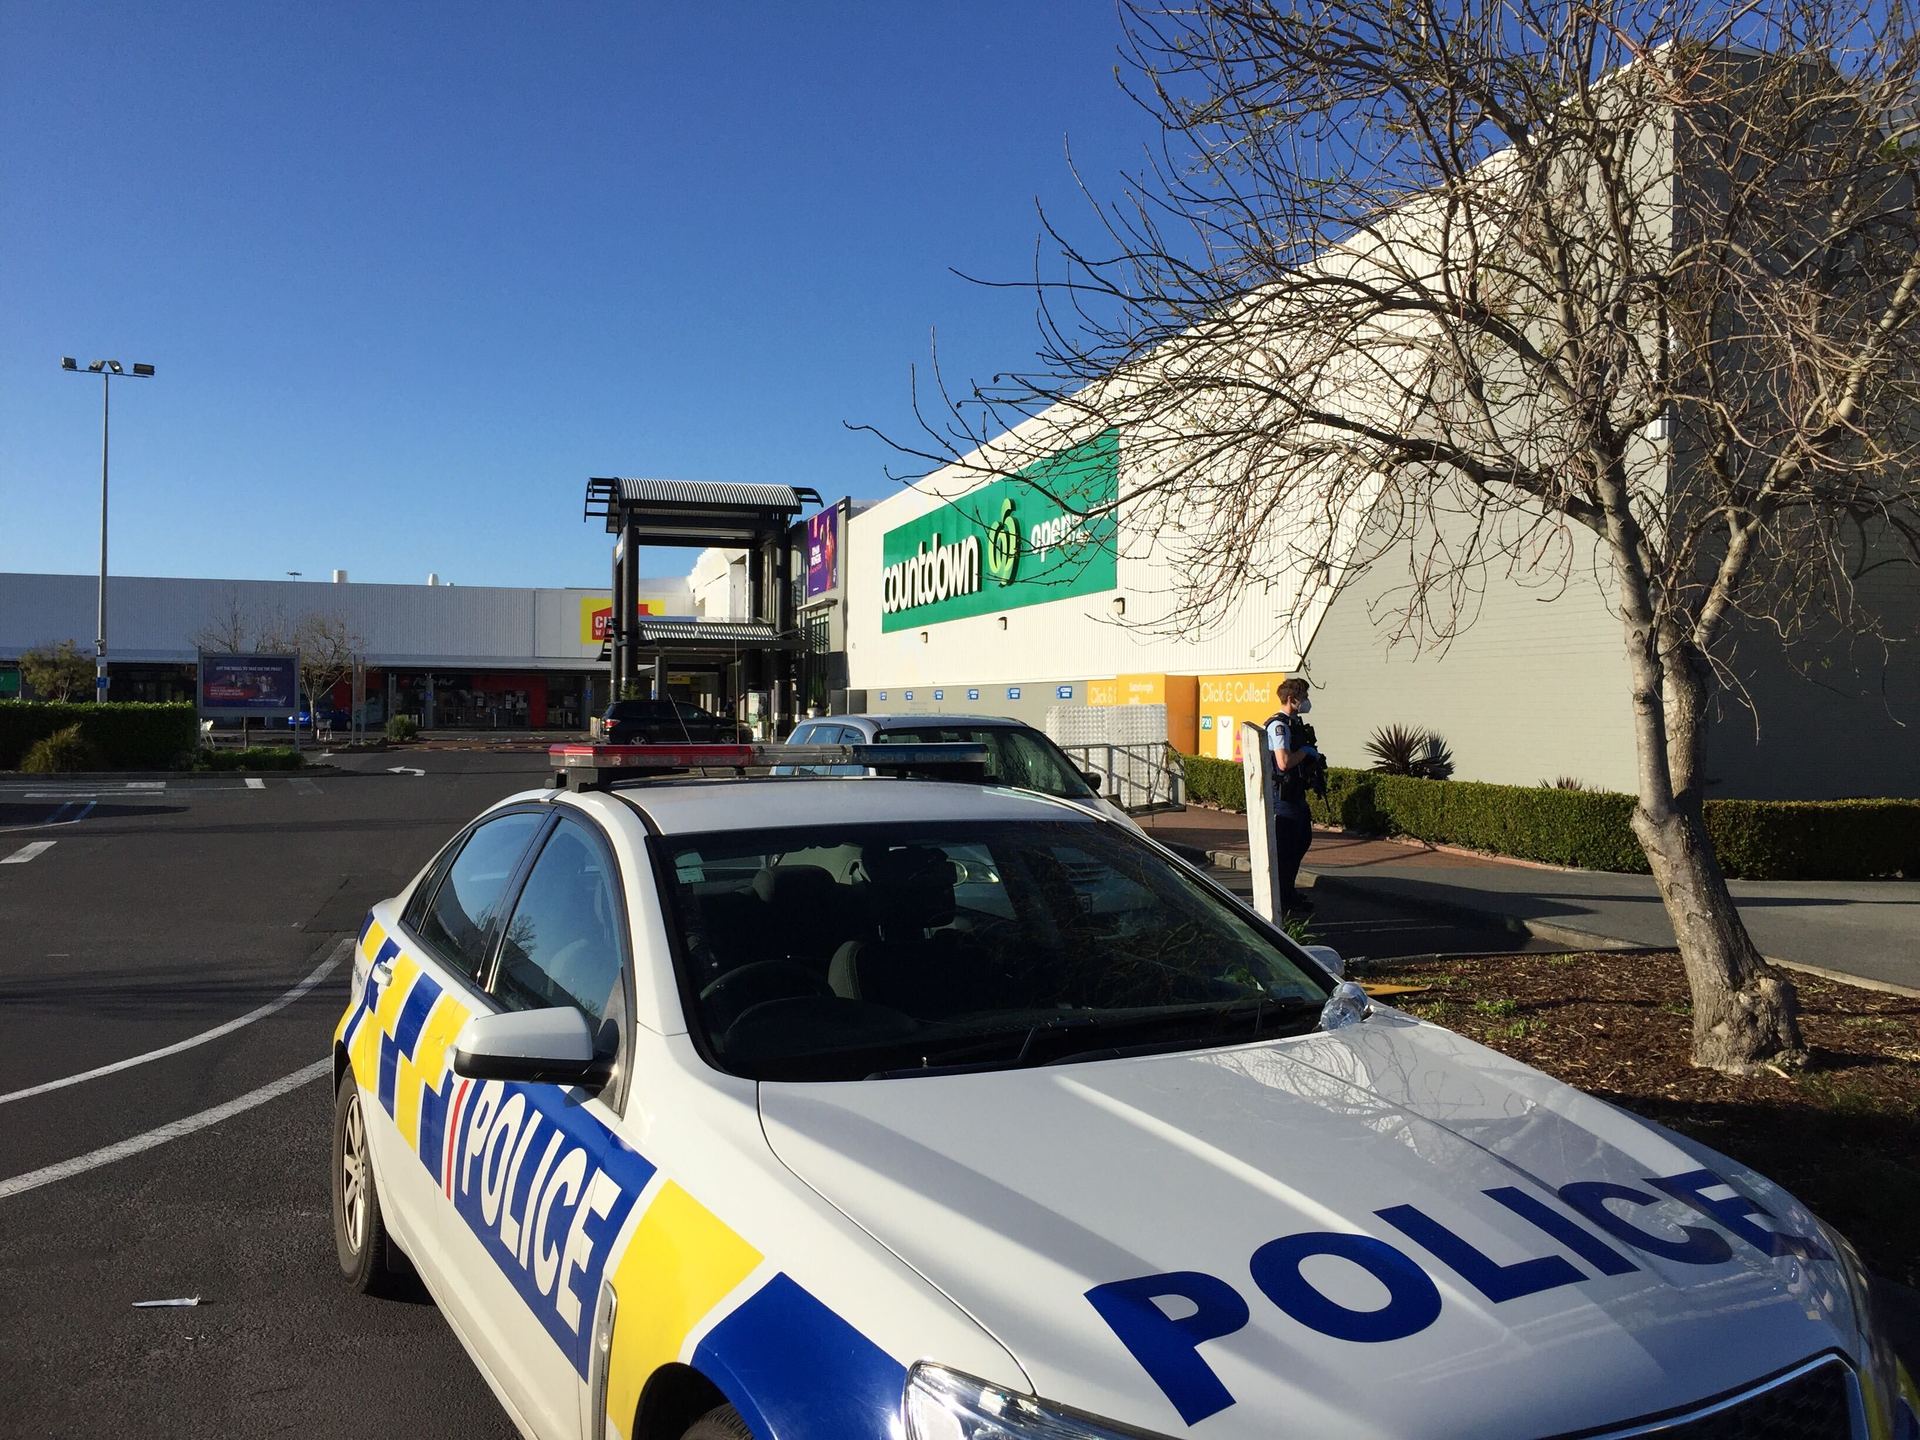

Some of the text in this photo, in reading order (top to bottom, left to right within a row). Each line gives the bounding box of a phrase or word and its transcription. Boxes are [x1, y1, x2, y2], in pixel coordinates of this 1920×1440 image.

[883, 532, 981, 614] countdown
[1031, 514, 1073, 562] open
[1201, 682, 1271, 703] Click & Collect
[462, 1080, 622, 1337] POLICE
[1084, 1167, 1834, 1427] POLICE
